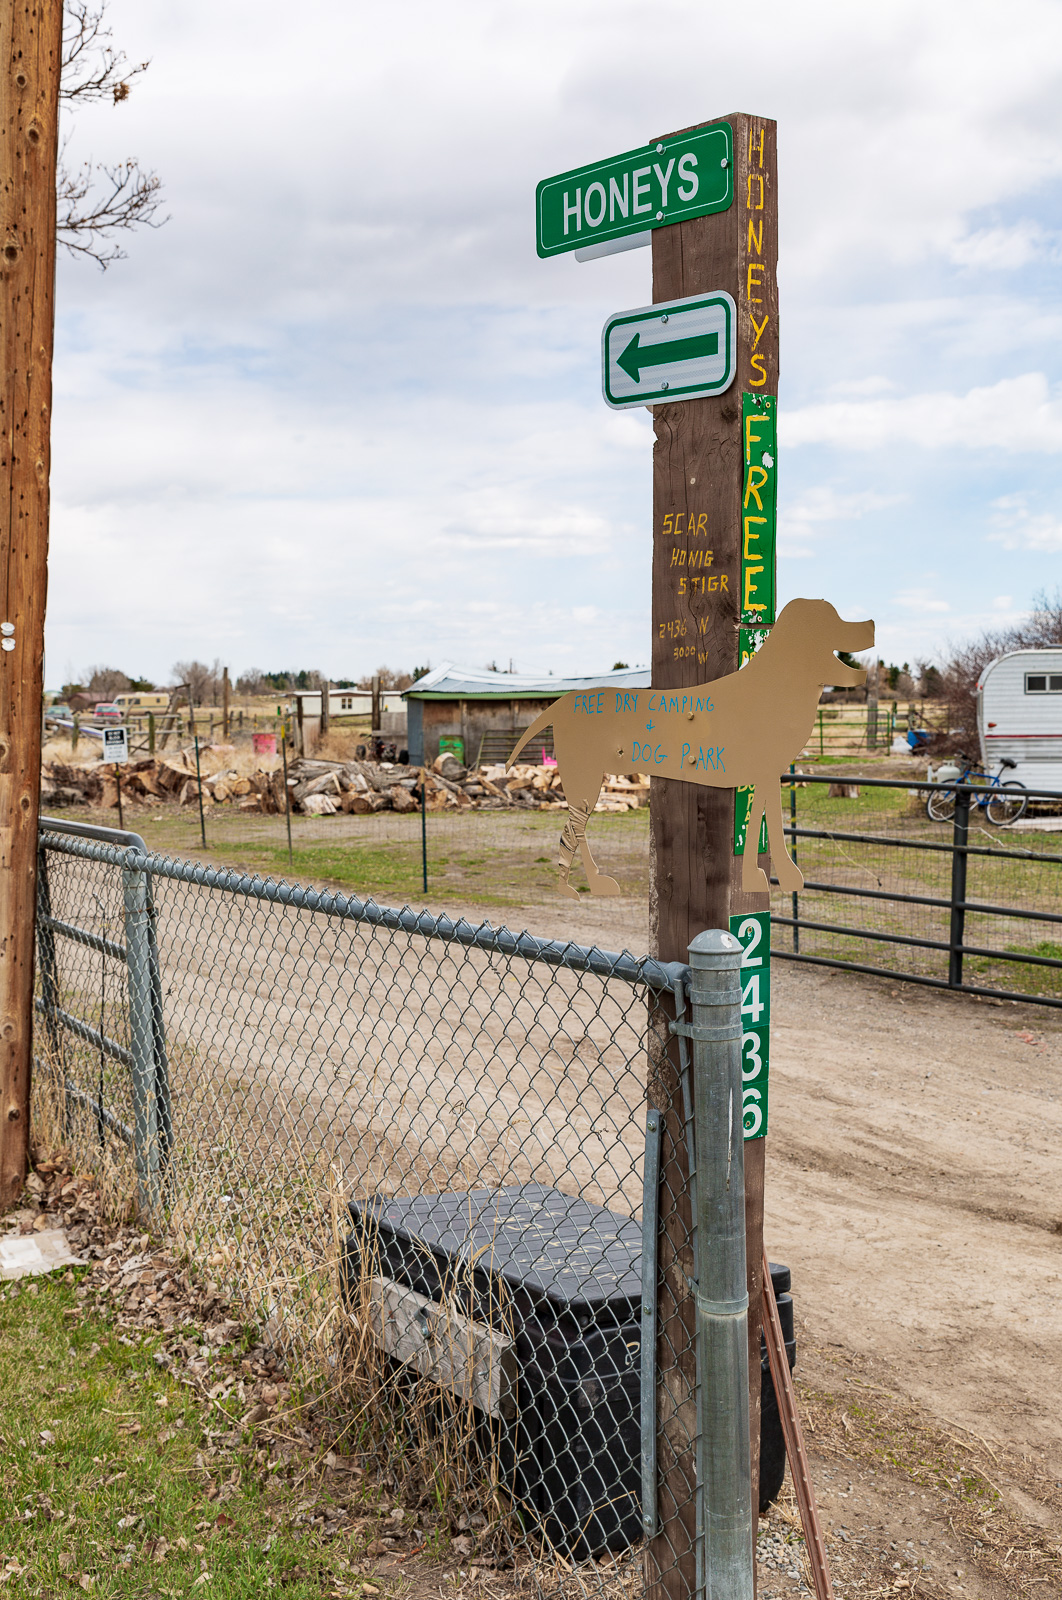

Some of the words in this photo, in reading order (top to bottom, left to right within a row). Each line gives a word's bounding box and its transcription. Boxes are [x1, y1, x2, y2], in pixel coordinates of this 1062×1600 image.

[563, 152, 699, 236] HONEYS
[747, 127, 769, 387] HONEYS
[744, 415, 770, 611] FREE
[669, 547, 714, 568] HONIG
[659, 618, 687, 638] 2436
[699, 616, 710, 634] N
[673, 645, 696, 661] 3000
[573, 692, 605, 715] FREE
[615, 692, 639, 713] DRY
[648, 694, 715, 713] CAMPING
[631, 741, 668, 764] DOG
[680, 743, 726, 773] PARK
[738, 917, 765, 1139] 2436
